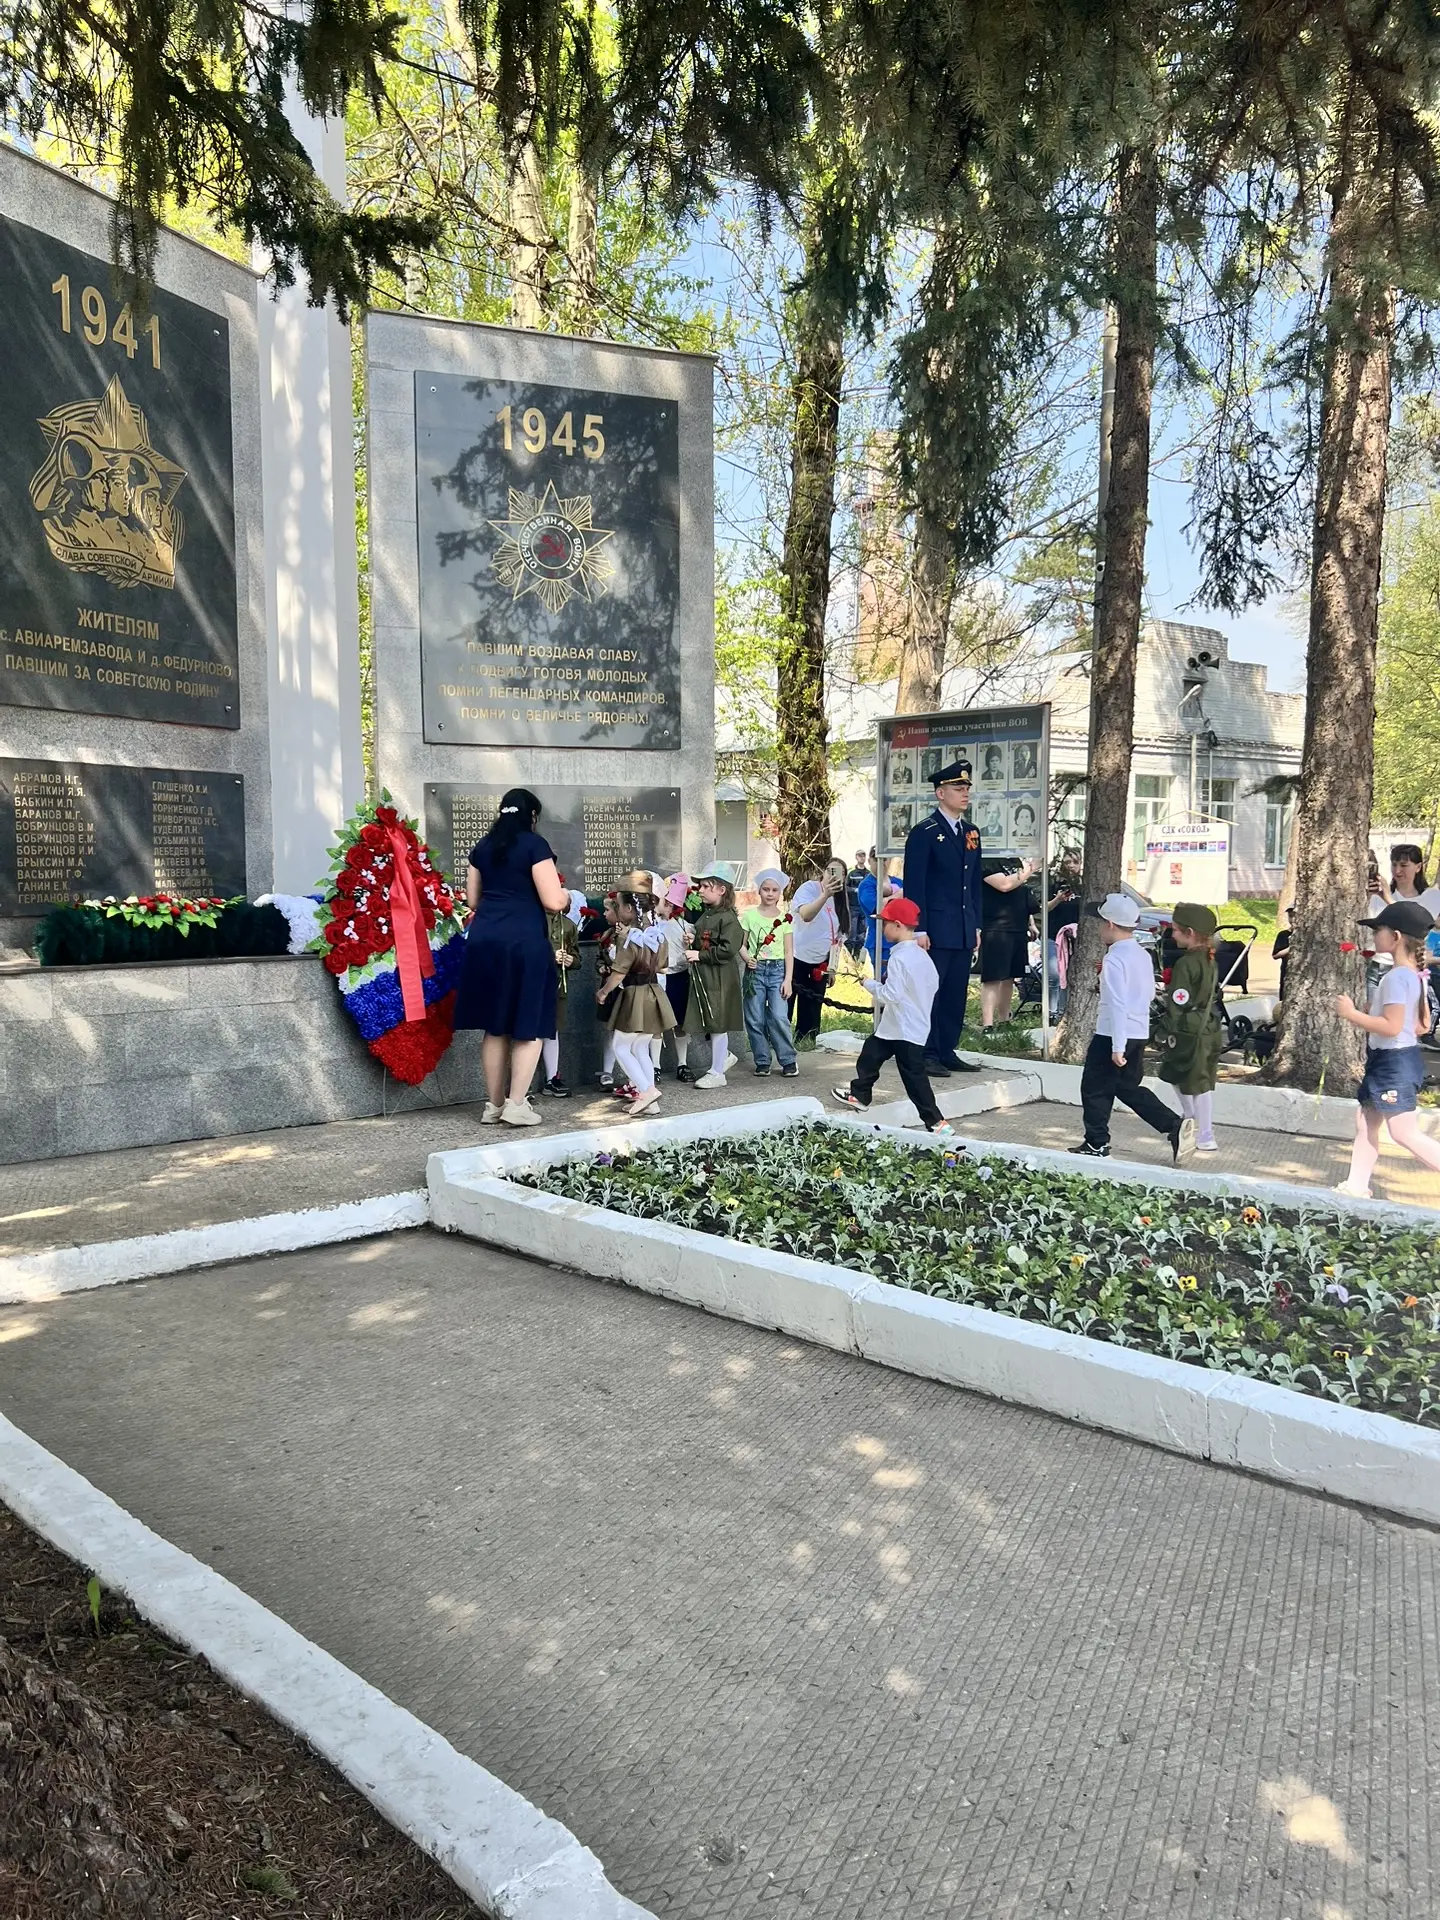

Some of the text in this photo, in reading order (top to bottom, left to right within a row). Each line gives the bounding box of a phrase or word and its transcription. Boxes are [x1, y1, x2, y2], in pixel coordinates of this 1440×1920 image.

[51, 273, 161, 370] 1941
[496, 405, 605, 459] 1945
[521, 515, 582, 571] ОТЕЧЕСТВЕННАЯ ВОЙНА
[55, 547, 137, 570] СЛАВА СОВЕТСКОЙ
[77, 607, 160, 641] ЖИТЕЛЯМ
[15, 628, 133, 663] АВИАРЕМЗАВОДА
[138, 649, 146, 664] И
[151, 655, 162, 668] д.
[467, 641, 641, 664] ПАВШИМ ВОЗДАВАЯ СЛАВУ,
[5, 654, 220, 698] ПАВШИМ ЗА СОВЕТСКУЮ РОДИНУ
[471, 663, 528, 679] ПОДВИГУ
[533, 667, 582, 680] ГОТОВЯ
[439, 684, 669, 705] ПОМНИ ЛЕГЕНДАРНЫХ КОМАНДИРОВ,
[461, 707, 649, 725] ПОМНИ О ВЕЛИЧЬЕ РЯДОВЫХ!
[908, 718, 1028, 735] Наши земляки участники ВОВ
[13, 772, 61, 784] АБРАМОВ
[14, 785, 65, 796] АГРЕЛКИН
[14, 797, 54, 808] БАБКИН
[152, 792, 180, 803] ЗИМИН
[452, 794, 494, 802] МОРОЗОВ
[152, 803, 199, 814] КОРНИЕНКО
[452, 803, 494, 811] МОРОЗОВ
[583, 805, 615, 813] РАСЕИЧ
[15, 809, 62, 820] БАРАНОВ
[153, 814, 203, 825] КРИВОРУЧКО
[452, 812, 495, 820] МОРОЗОВ
[583, 814, 640, 822] СТРЕЛЬНИКОВ
[15, 821, 75, 833] БОБРУНЦОВ
[153, 825, 183, 835] КУДЕЛЯ
[584, 822, 621, 830] ТИХОНОВ
[1162, 825, 1210, 834] СДК «СОКОЛ»
[16, 833, 75, 844] БОБРУНЦОВ
[153, 836, 189, 845] КУЗЬМИН
[584, 831, 621, 839] ТИХОНОВ
[584, 840, 621, 848] ТИХОНОВ
[16, 845, 76, 857] БОБРУНЦОВ
[154, 846, 189, 856] ЛЕБЕДЕВ
[584, 849, 612, 857] ФИЛИН
[16, 857, 65, 868] БРЫКСИН
[154, 857, 190, 867] МАТВЕЕВ
[17, 869, 63, 880] ВАСЬКИН
[154, 868, 191, 878] МАТВЕЕВ
[584, 866, 623, 874] ЩАВЕЛЕВ
[585, 875, 620, 883] ЩАВЕЛЕ
[18, 881, 51, 892] ГАНИН
